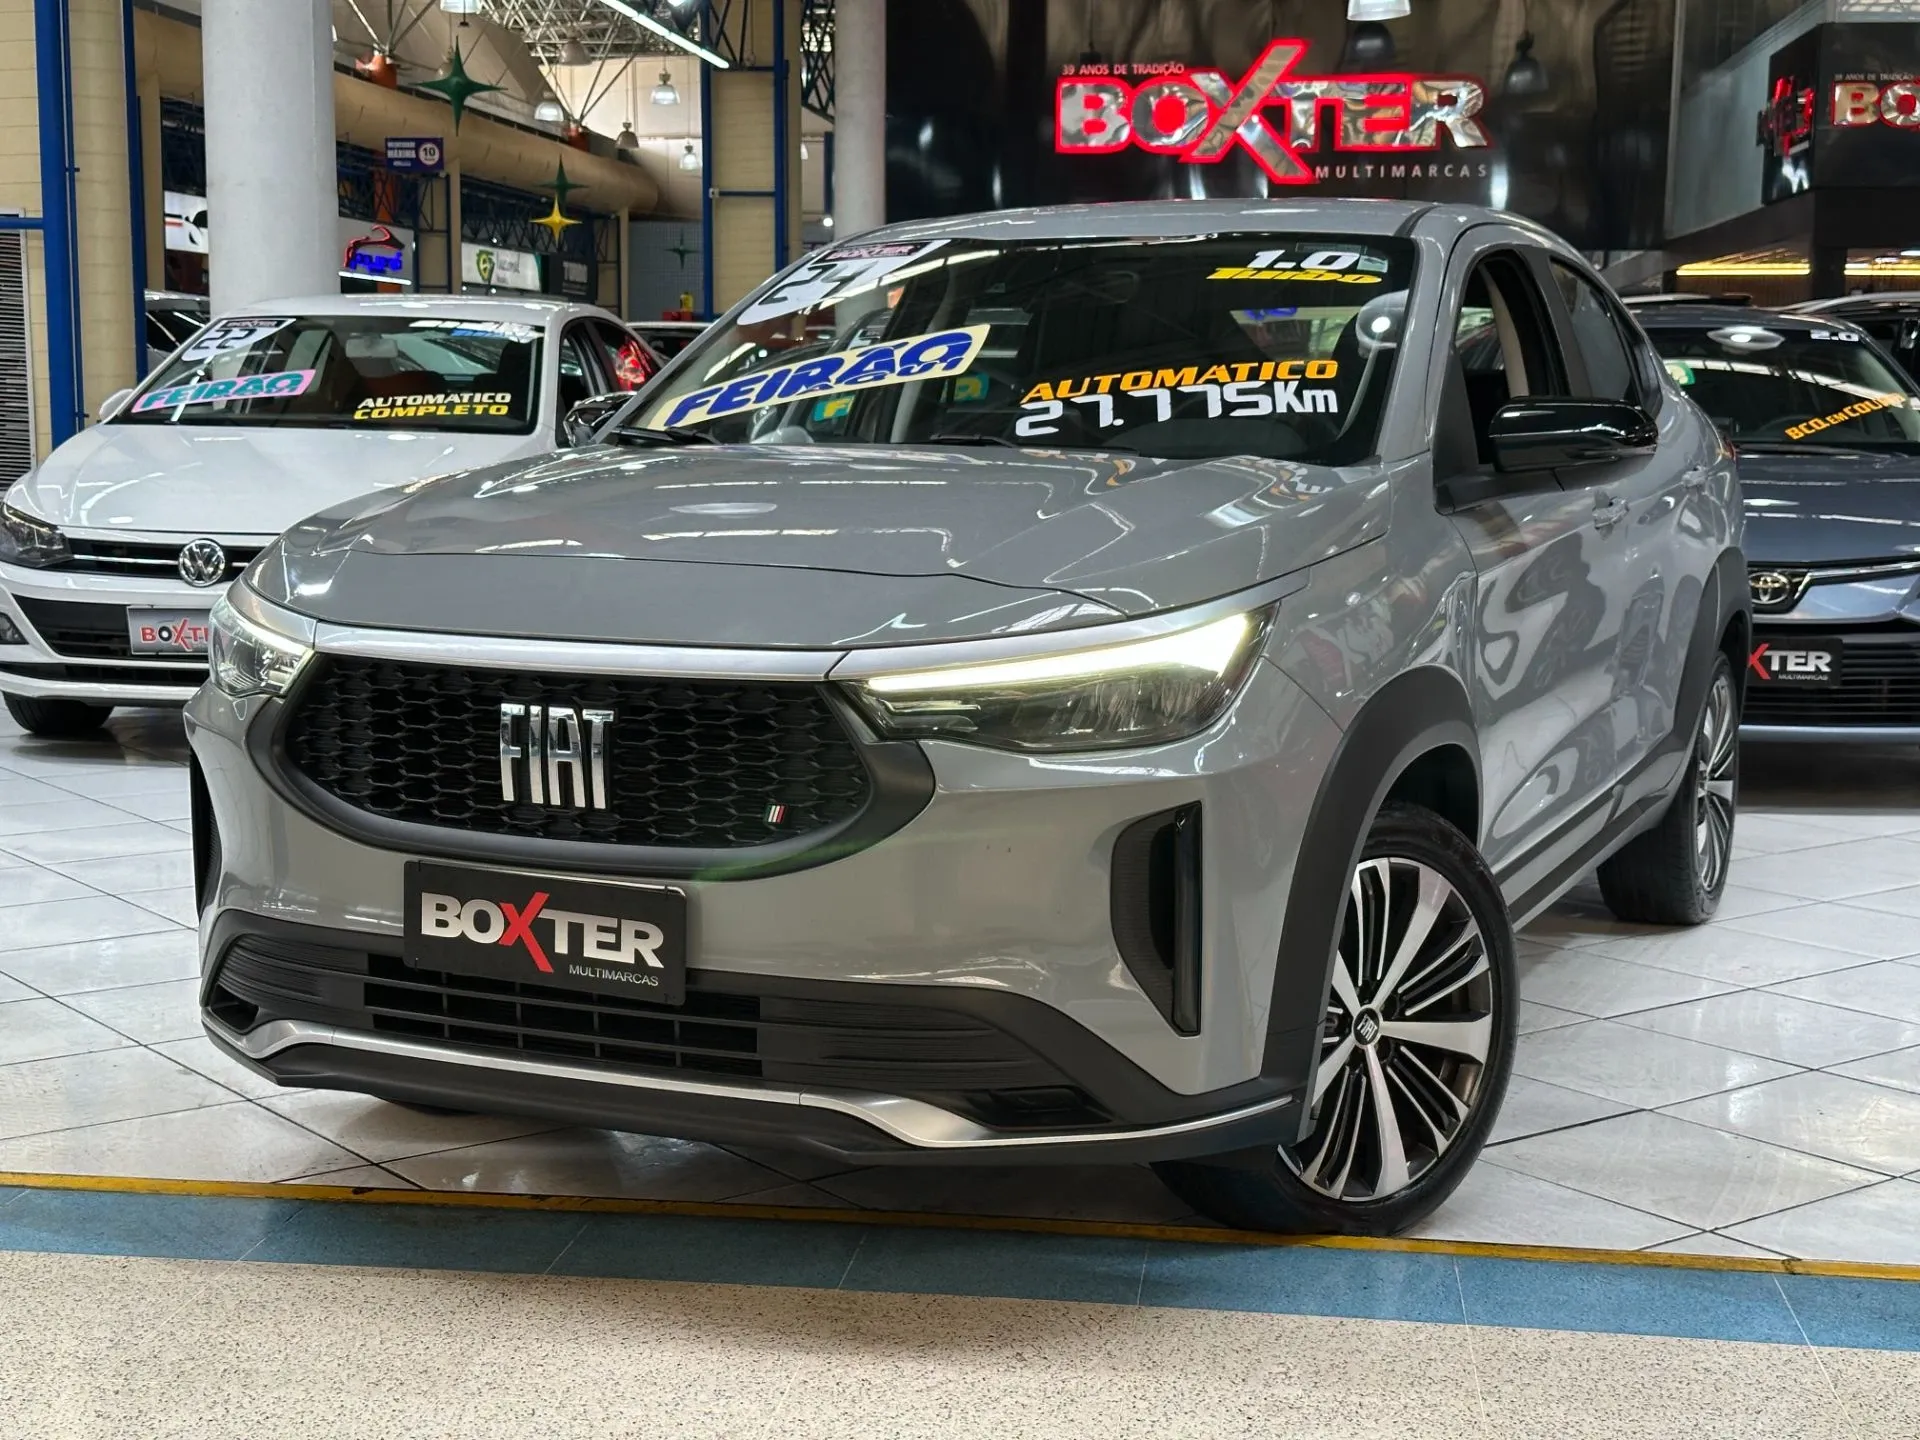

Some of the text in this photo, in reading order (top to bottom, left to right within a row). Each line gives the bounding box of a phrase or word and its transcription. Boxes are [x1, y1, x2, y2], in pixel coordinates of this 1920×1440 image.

[1062, 62, 1186, 76] 39 ANOS DE TRADIÇÃO
[1055, 39, 1493, 184] BOXTER
[422, 147, 436, 157] 10
[1315, 164, 1488, 179] MULTIMARCAS
[1246, 249, 1361, 271] 1.0
[191, 328, 258, 351] 22
[1810, 329, 1860, 342] 2.0
[139, 372, 305, 409] FEIRÃO
[664, 331, 973, 427] FEIRÃO
[353, 403, 510, 420] COMPLETO
[500, 702, 615, 809] FIAT
[421, 891, 665, 974] BOXTER
[568, 963, 660, 988] MULTIMARCAS
